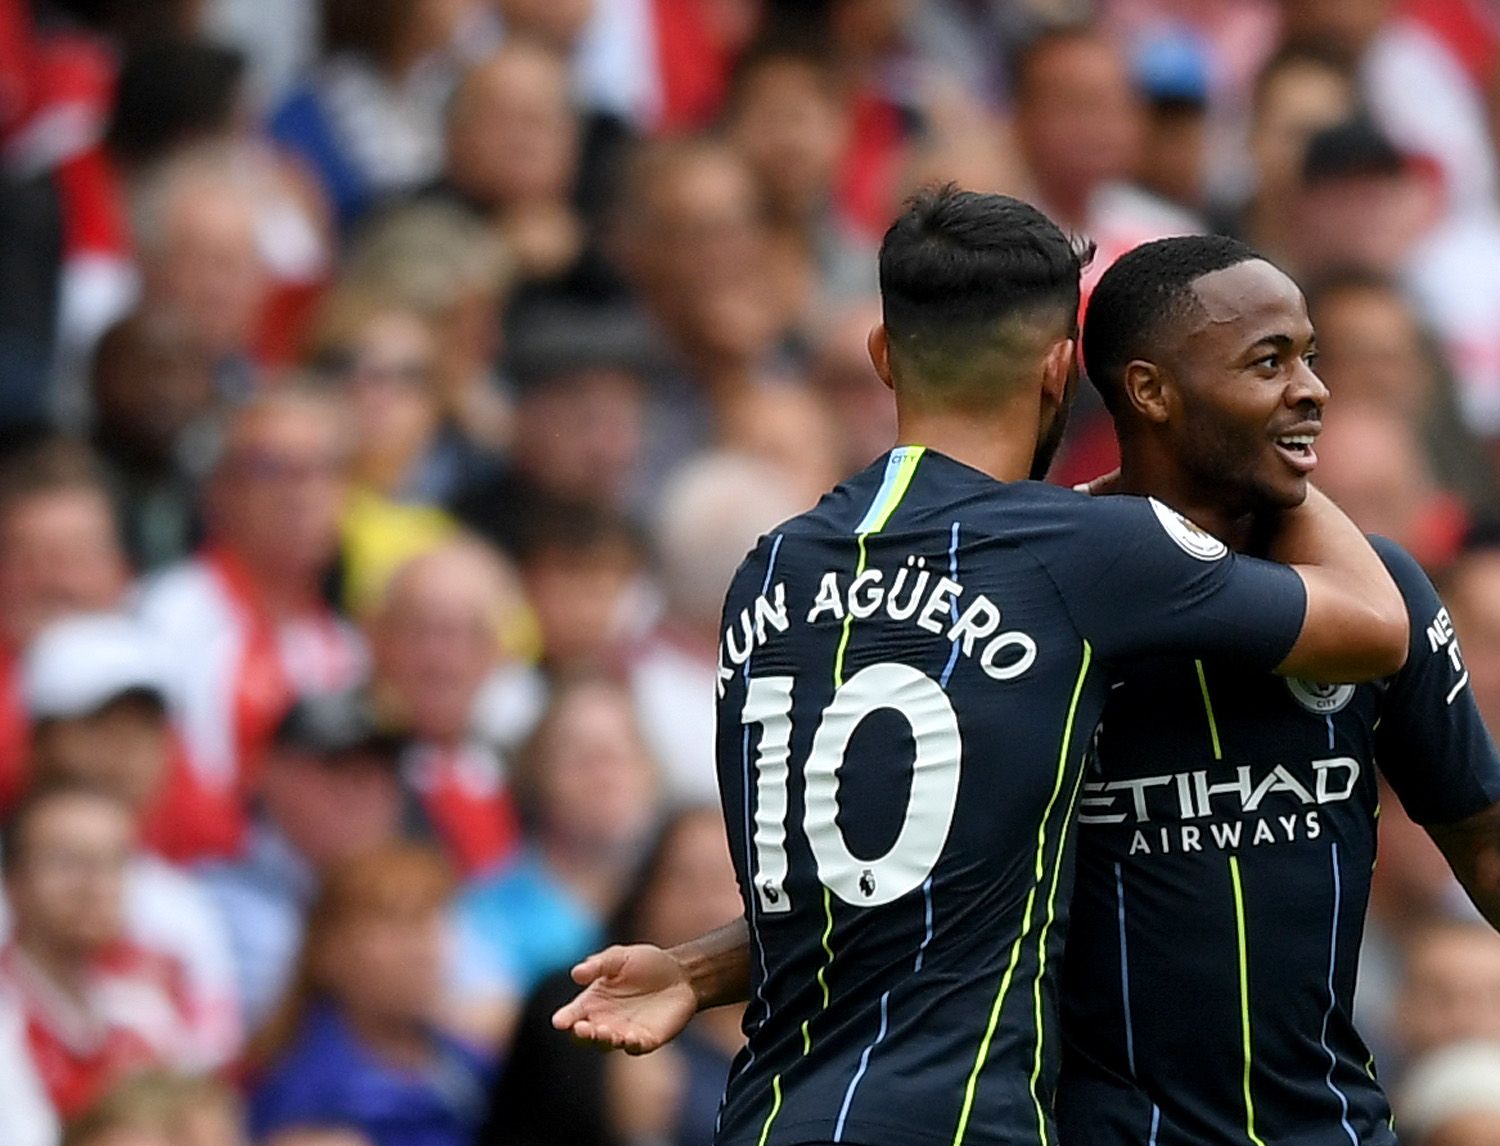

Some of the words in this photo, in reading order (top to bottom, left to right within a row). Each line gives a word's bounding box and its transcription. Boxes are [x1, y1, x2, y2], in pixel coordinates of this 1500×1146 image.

[806, 554, 1037, 680] AGÜERO
[741, 662, 962, 913] 10
[1077, 756, 1361, 823] ETIHAD
[1129, 810, 1321, 855] AIRWAYS
